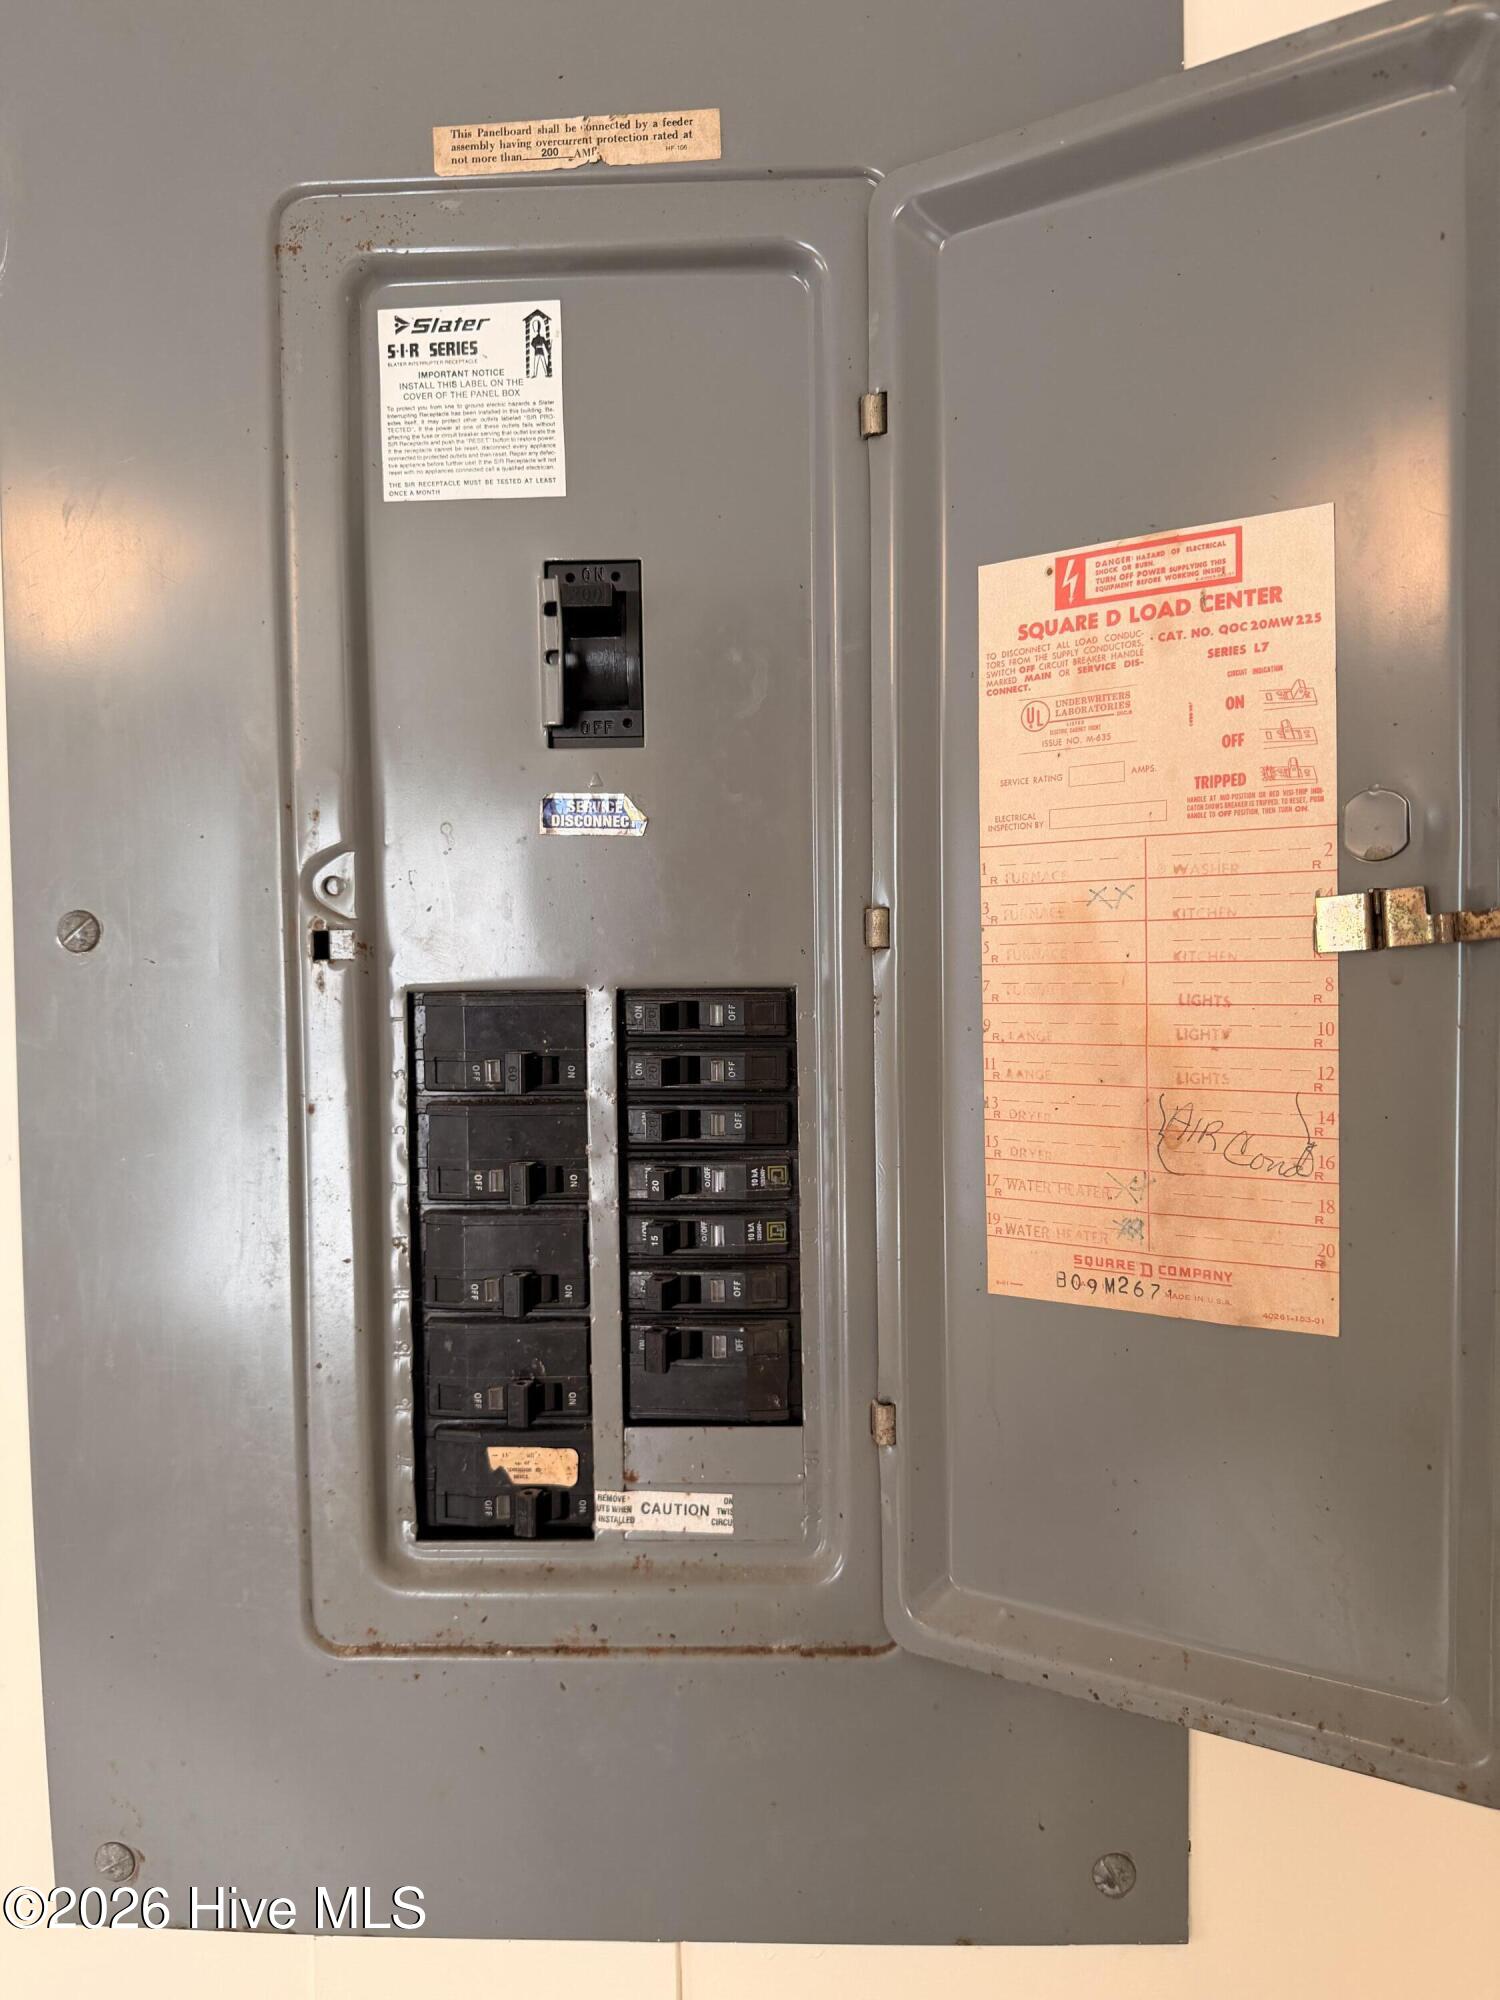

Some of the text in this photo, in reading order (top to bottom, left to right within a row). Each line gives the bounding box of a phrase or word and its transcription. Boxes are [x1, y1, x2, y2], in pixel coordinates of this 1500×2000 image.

[450, 128, 472, 139] This
[477, 125, 531, 137] Panelboard
[537, 123, 559, 134] shall
[564, 122, 576, 133] be
[635, 118, 648, 131] by
[662, 115, 693, 127] feeder
[451, 129, 692, 154] assembly having overcurrent protection rated at
[451, 156, 469, 165] not
[471, 155, 496, 164] more
[500, 152, 522, 162] than
[541, 147, 559, 158] 200
[411, 317, 491, 335] Slater
[429, 340, 477, 356] SERIES
[418, 368, 504, 378] IMPORTANT NOTICE
[399, 377, 523, 390] INSTALL THIS LABEL ON THE
[402, 388, 520, 400] COVER OF THE PANEL BOX
[1095, 540, 1227, 568] DANGER: HAZARD OF ELECTRICAL
[581, 567, 605, 583] ON
[1095, 560, 1153, 576] SHOCK OR BURN.
[1095, 557, 1226, 584] TURN OFF POWER SUPPLYING THIS
[1095, 580, 1133, 592] EQUIPMENT
[1136, 575, 1161, 586] BEFORE
[1164, 570, 1199, 581] WORKING
[1202, 565, 1226, 577] INSIDE
[1017, 585, 1282, 641] SQUARE D LOAD CENTER
[1157, 629, 1187, 642] CAT.
[1190, 625, 1213, 638] NO.
[986, 630, 1144, 661] TO DISCONNECT ALL LOAD CONDUC-
[1207, 641, 1269, 658] SERIES L7
[985, 640, 1144, 669] TORS FROM THE SUPPLY CONDUCTORS,
[985, 649, 1144, 678] SWITCH OFF CIRCUIT BREAKER HANDLE
[986, 660, 1144, 687] MARKED MAIN OR SERVICE DIS-
[986, 684, 1031, 696] CONNECT.
[1055, 692, 1130, 708] UNDERWRITERS
[1225, 696, 1245, 710] ON
[1055, 701, 1131, 717] LABORATORIES
[581, 720, 614, 736] OFF
[1041, 734, 1111, 747] ISSUE NO. M-635
[1221, 734, 1245, 748] OFF
[1131, 765, 1157, 774] AMPS.
[1000, 776, 1063, 787] SERVICE RATING
[1193, 772, 1247, 789] TRIPPED
[567, 799, 624, 814] SERVICE
[994, 812, 1036, 823] ELECTRICAL
[987, 822, 1032, 832] INSPECTION
[1324, 843, 1334, 858] 2
[1173, 863, 1239, 875] WASHER
[1172, 907, 1238, 919] KITCHEN
[1172, 950, 1238, 962] KITCHEN
[1325, 977, 1334, 991] 8
[1178, 994, 1232, 1008] LIGHTS
[635, 1005, 643, 1019] ON
[728, 1004, 736, 1021] OFF
[1318, 1022, 1335, 1036] 10
[471, 1065, 481, 1082] OFF
[508, 1066, 518, 1082] 60
[567, 1065, 575, 1079] ON
[635, 1062, 643, 1076] ON
[728, 1061, 736, 1078] OFF
[1318, 1067, 1335, 1081] 12
[1176, 1073, 1231, 1085] LIGHTS
[734, 1112, 742, 1129] OFF
[1319, 1112, 1335, 1125] 14
[985, 1136, 999, 1148] 15
[1319, 1155, 1335, 1169] 16
[474, 1174, 483, 1191] OFF
[570, 1174, 577, 1188] ON
[652, 1180, 660, 1192] 20
[986, 1174, 999, 1187] 17
[1319, 1200, 1335, 1213] 18
[987, 1212, 1001, 1225] 19
[651, 1235, 659, 1246] 15
[1005, 1223, 1109, 1244] WATER HEATER
[1318, 1244, 1335, 1258] 20
[1073, 1254, 1233, 1281] SQUARE D COMPANY
[565, 1284, 572, 1298] ON
[733, 1280, 741, 1297] OFF
[474, 1392, 482, 1408] OFF
[569, 1391, 576, 1406] ON
[597, 1494, 626, 1502] REMOVE
[579, 1500, 586, 1513] ON
[611, 1505, 632, 1513] WHEN
[641, 1501, 710, 1516] CAUTION
[598, 1515, 635, 1524] INSTALLED
